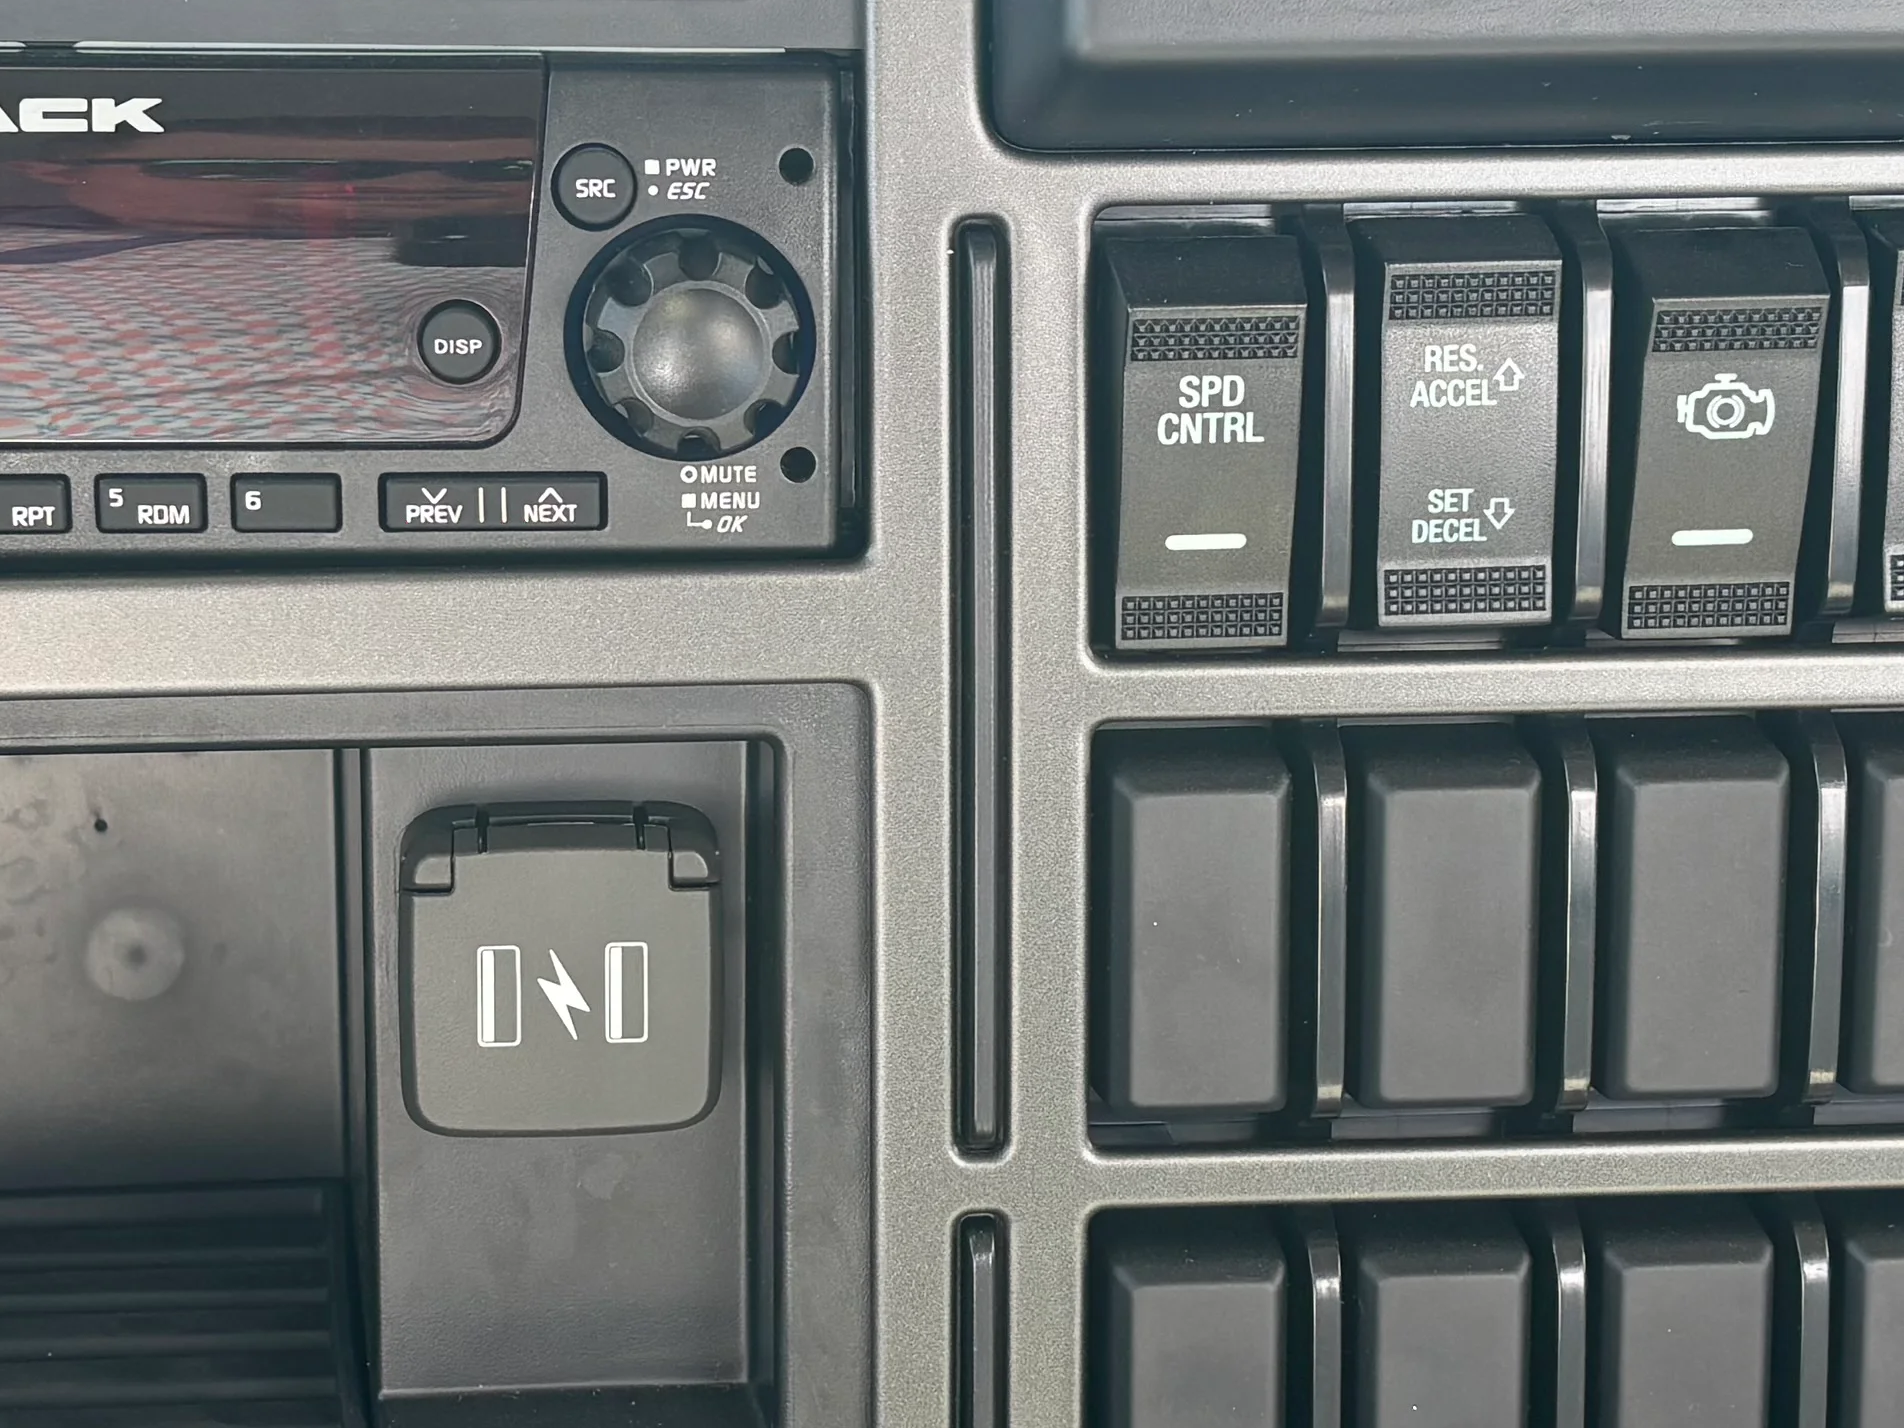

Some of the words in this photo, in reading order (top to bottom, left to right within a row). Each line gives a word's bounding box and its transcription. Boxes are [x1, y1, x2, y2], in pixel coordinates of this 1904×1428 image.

[665, 158, 717, 177] PWR
[575, 178, 616, 199] SRC
[666, 181, 711, 200] ESC
[434, 338, 483, 355] DISP
[1424, 343, 1485, 373] RES.
[1178, 374, 1245, 409] SPD
[1410, 379, 1497, 408] ACCEL
[1157, 411, 1265, 446] CNTRL
[700, 464, 757, 484] MUTE
[108, 488, 124, 508] 5
[244, 490, 262, 511] 6
[700, 491, 760, 510] MENU
[1427, 488, 1475, 514] SET
[11, 506, 56, 527] RPT
[137, 504, 190, 525] RDM
[405, 504, 463, 524] PREV
[523, 503, 578, 523] NEXT
[716, 514, 749, 533] OK
[1411, 518, 1487, 544] DECEL
